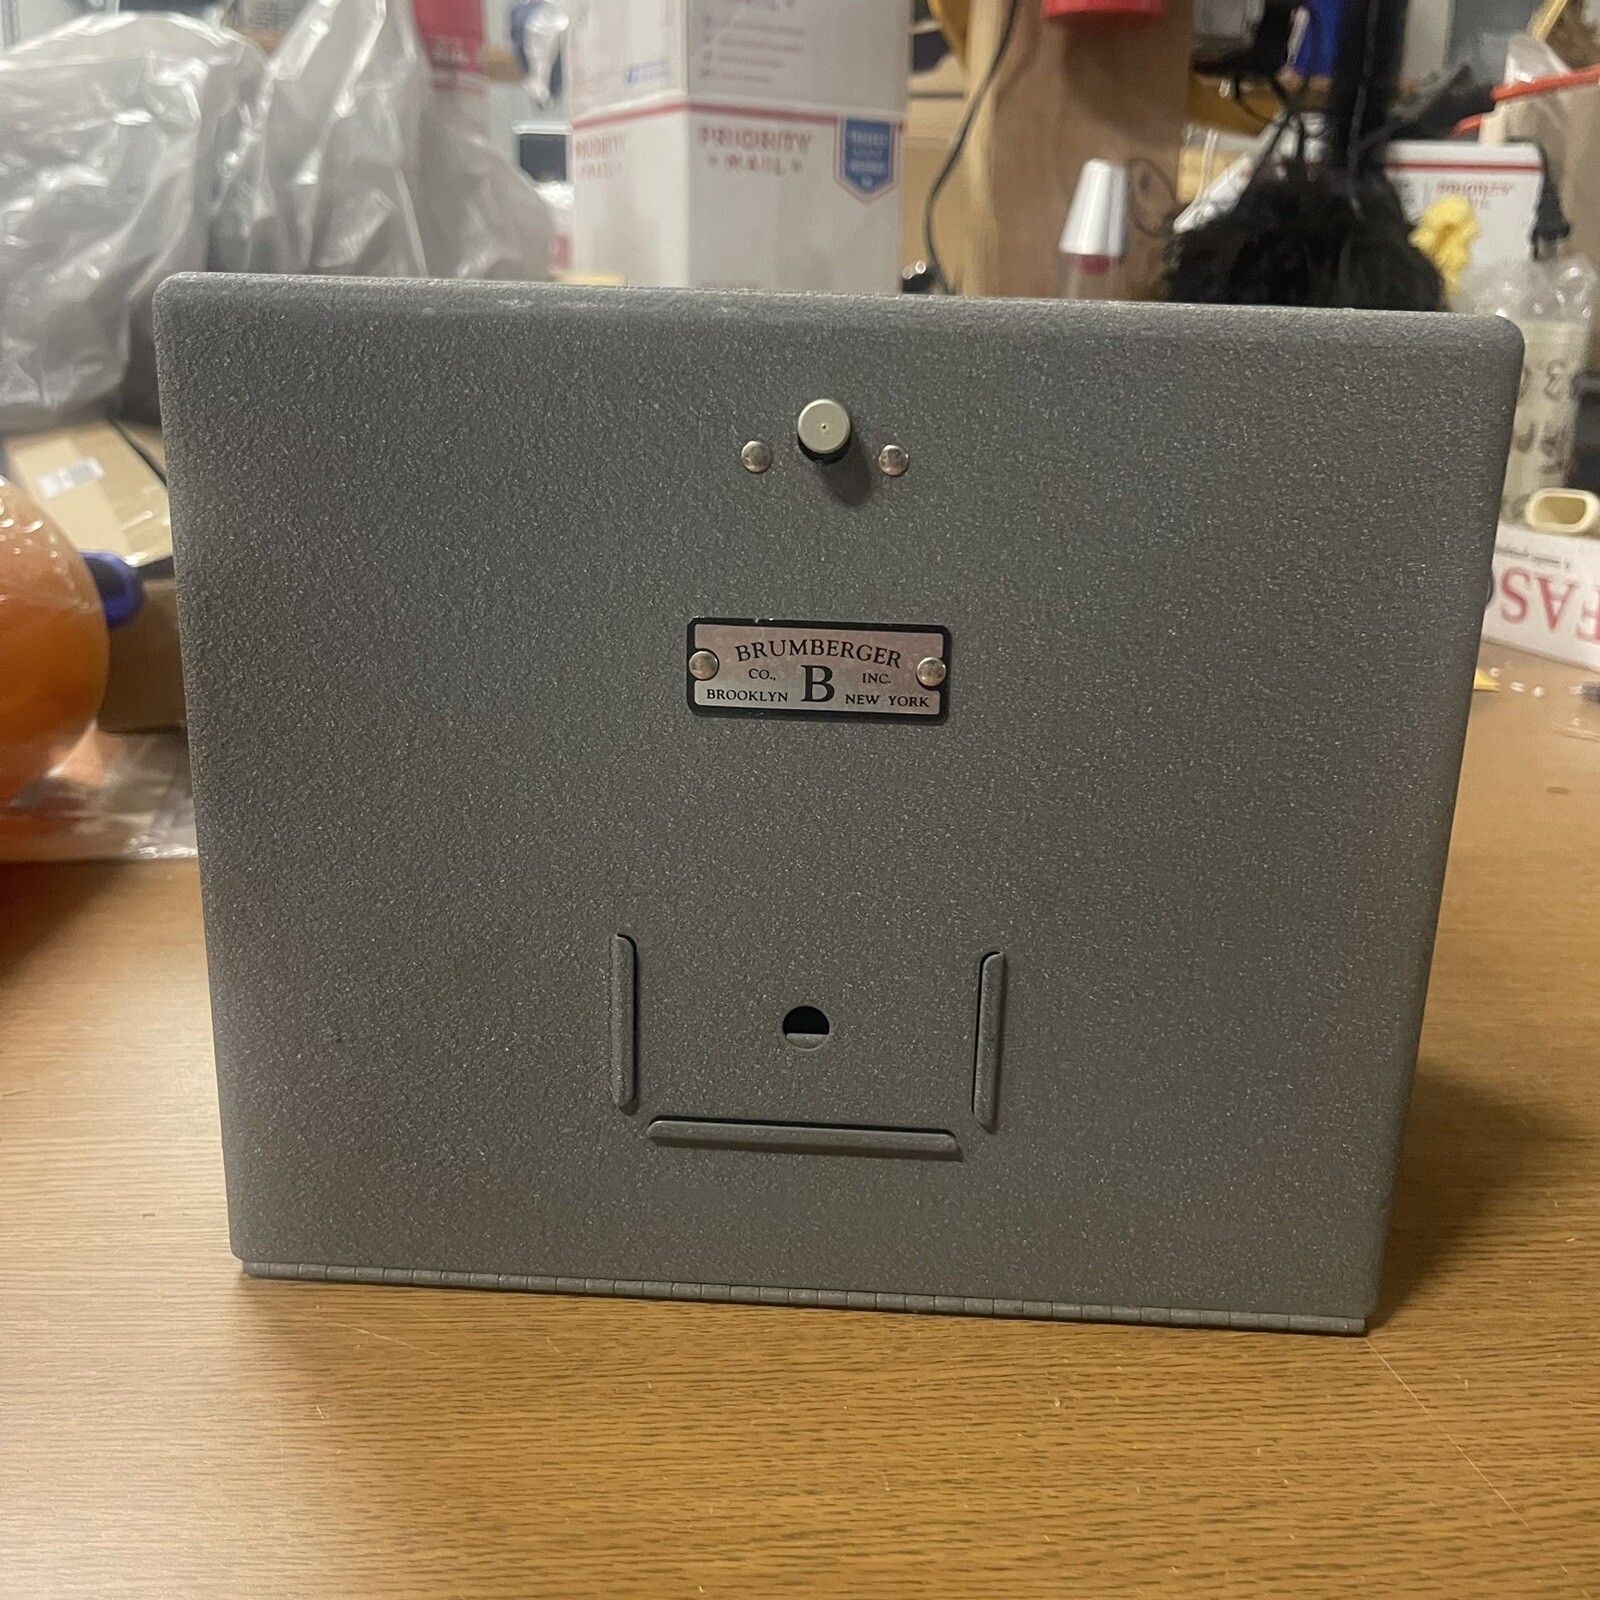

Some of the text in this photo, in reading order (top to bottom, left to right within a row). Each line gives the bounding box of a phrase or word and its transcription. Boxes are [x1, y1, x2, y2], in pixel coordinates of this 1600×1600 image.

[735, 639, 902, 669] BRUMBERGER
[748, 668, 777, 681] CO.,
[800, 665, 836, 703] B
[706, 689, 789, 702] BROOKLYN
[845, 693, 930, 708] NEW YORK
